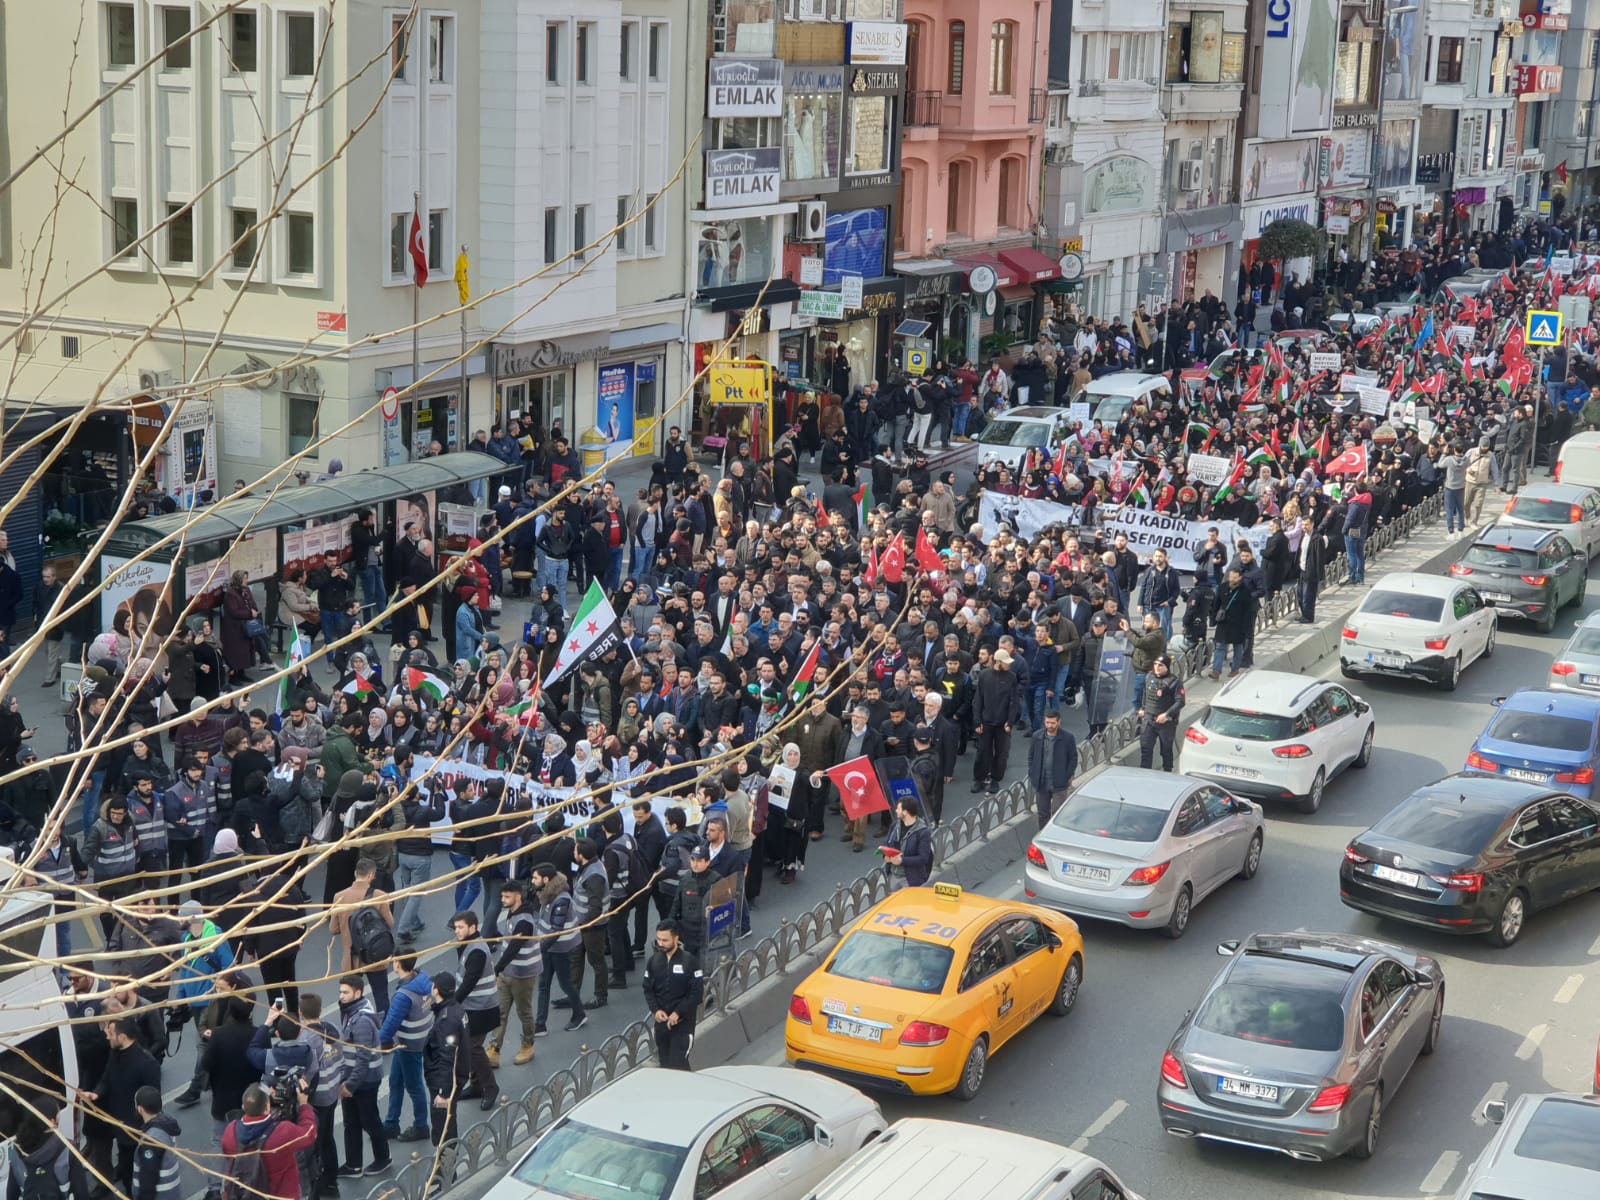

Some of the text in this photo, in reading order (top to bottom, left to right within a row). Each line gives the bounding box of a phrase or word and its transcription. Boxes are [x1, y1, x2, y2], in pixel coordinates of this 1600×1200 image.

[867, 72, 898, 88] SHEIKHA
[715, 87, 776, 105] EMLAK
[712, 175, 774, 196] EMLAK
[725, 386, 744, 399] Ptt
[874, 913, 957, 938] TJF 20
[834, 1020, 880, 1039] 34 TJF 20
[1224, 1080, 1234, 1090] 34
[1255, 1085, 1277, 1097] 3372
